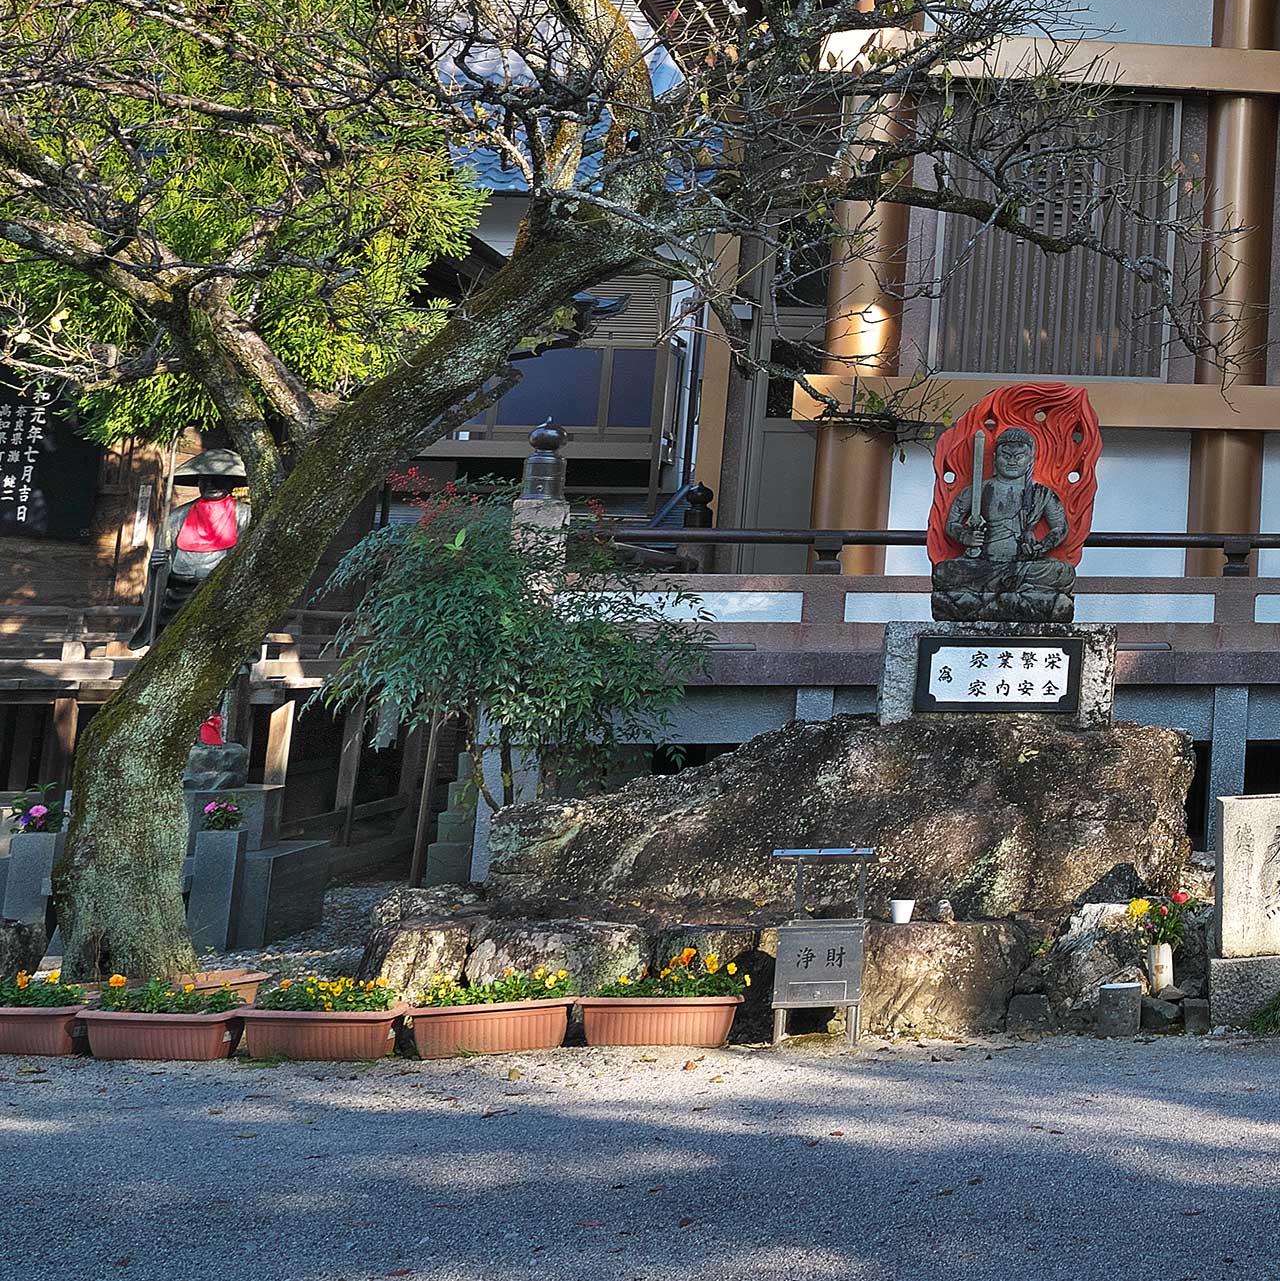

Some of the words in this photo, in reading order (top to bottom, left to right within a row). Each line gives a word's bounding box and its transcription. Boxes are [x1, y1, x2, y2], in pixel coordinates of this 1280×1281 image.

[969, 650, 1062, 670] 家業繁栄
[967, 679, 1060, 697] 家内安全
